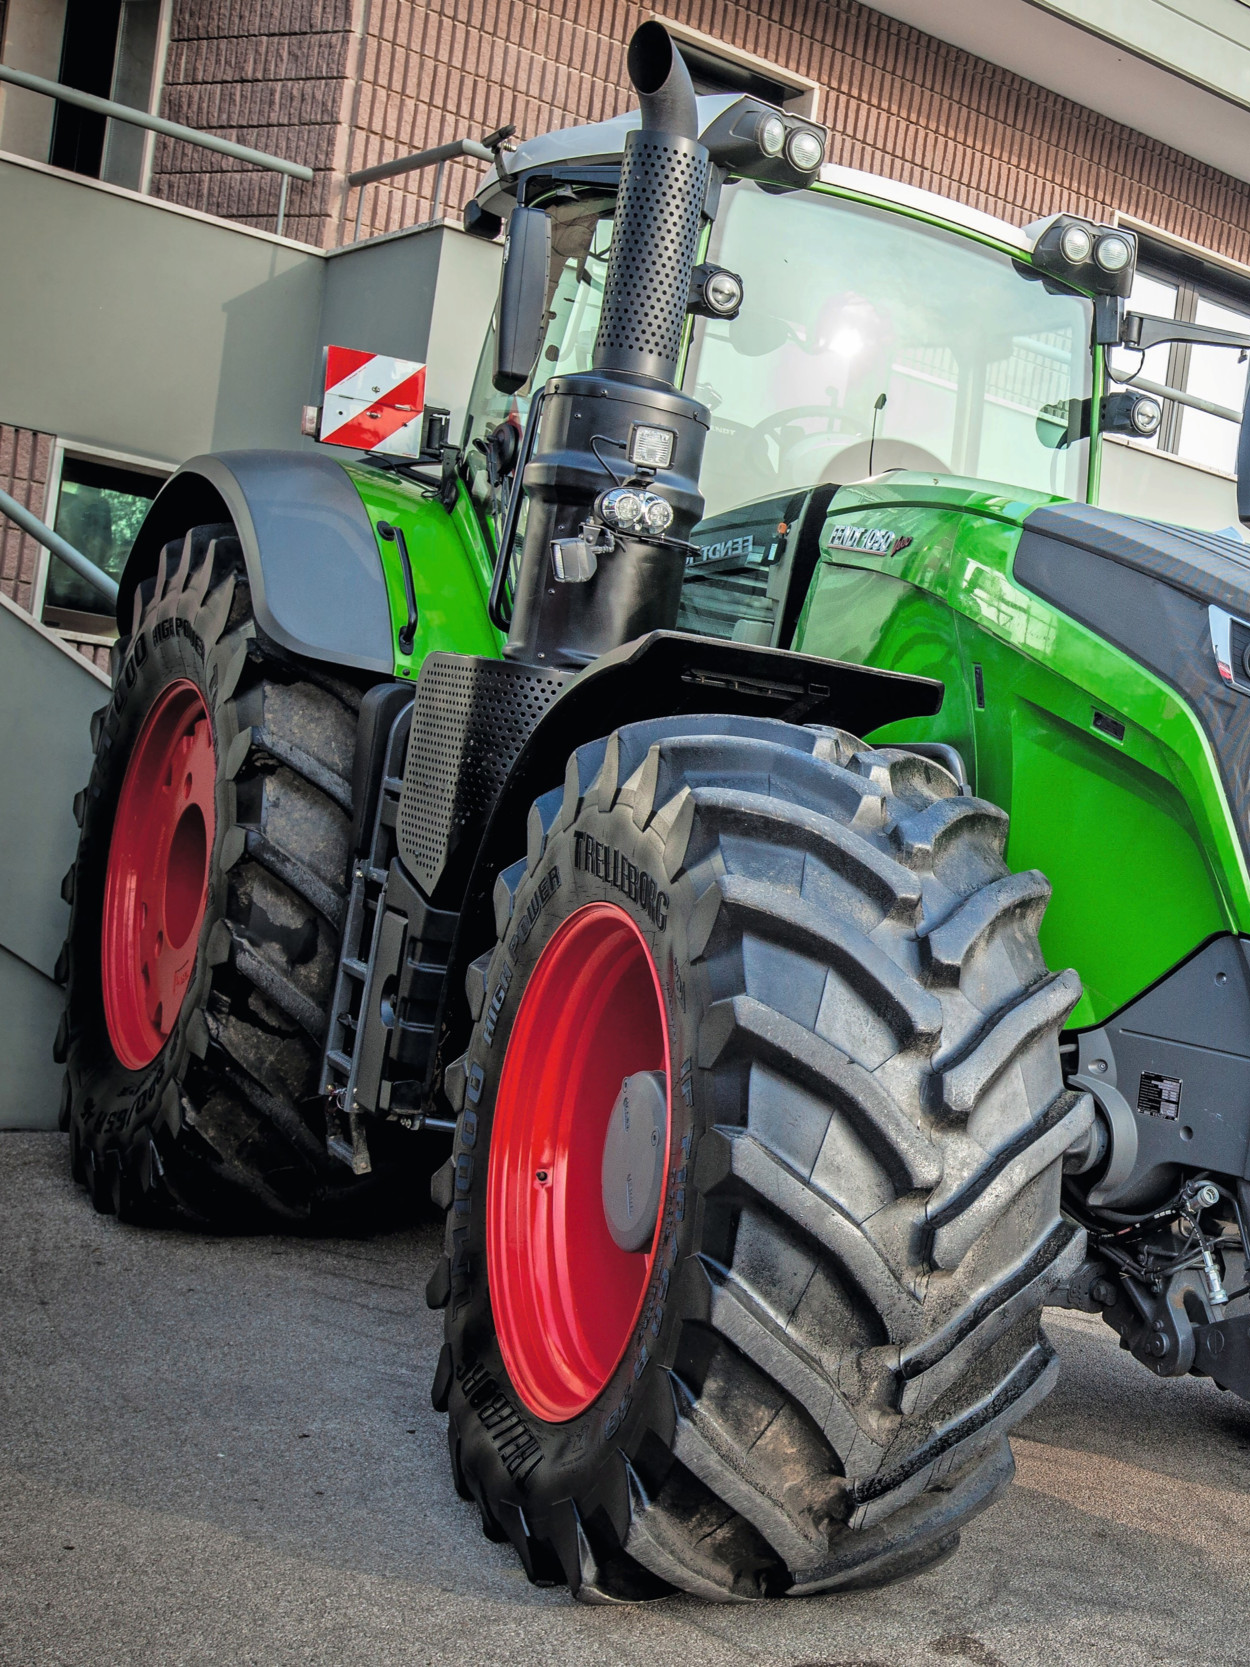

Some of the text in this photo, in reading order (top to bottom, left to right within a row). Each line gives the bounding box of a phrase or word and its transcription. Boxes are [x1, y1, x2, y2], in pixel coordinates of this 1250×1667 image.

[827, 525, 867, 548] FENDT
[861, 528, 896, 553] 1050
[573, 830, 669, 933] TRELLEBORG
[483, 865, 562, 1048] HIGH POWER
[456, 1362, 545, 1490] TRELLEBORG
